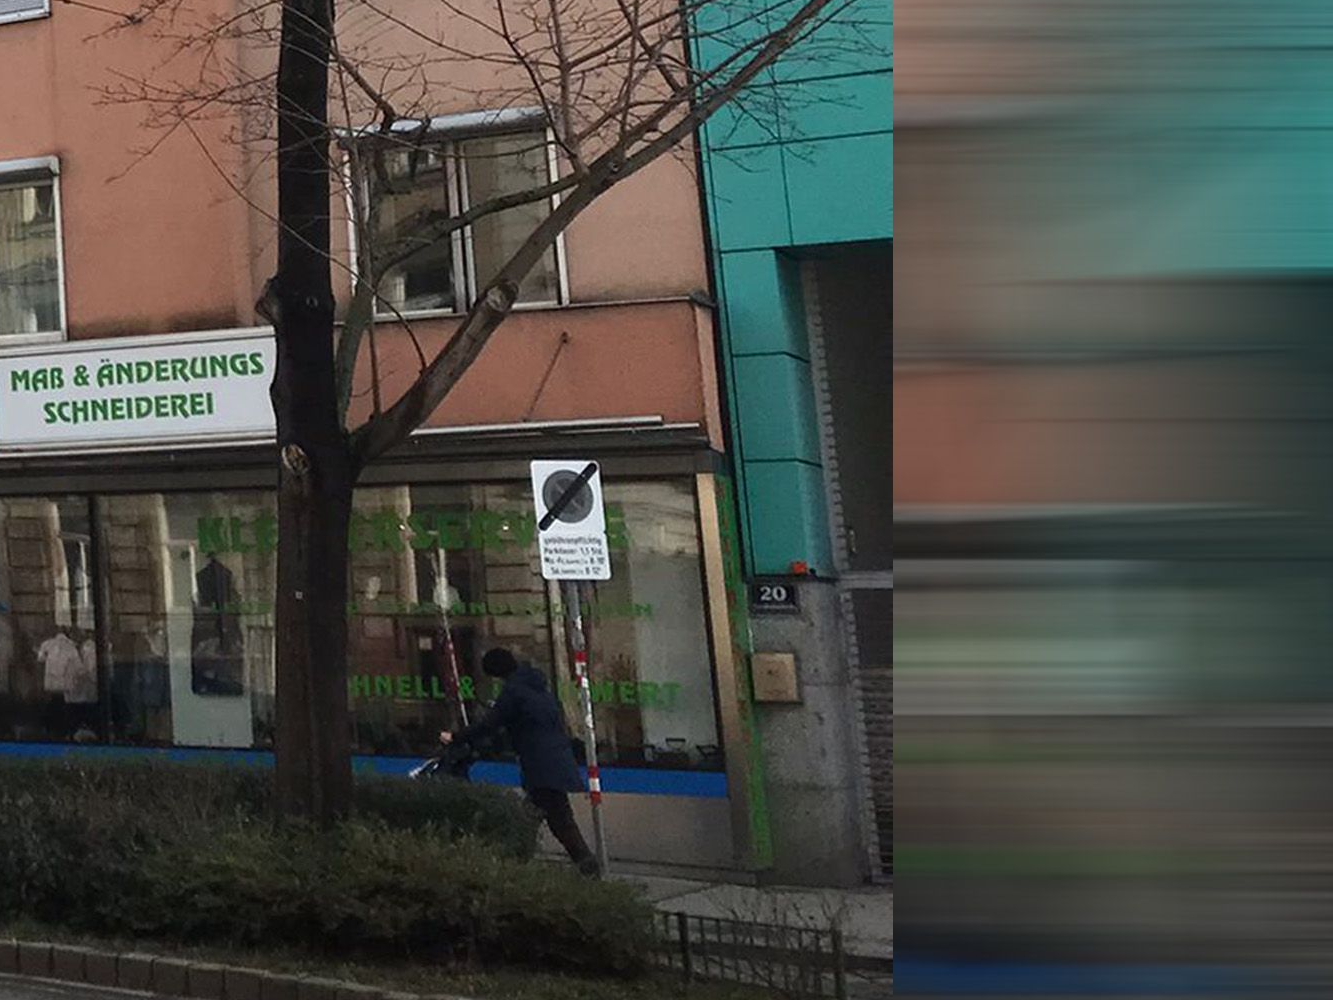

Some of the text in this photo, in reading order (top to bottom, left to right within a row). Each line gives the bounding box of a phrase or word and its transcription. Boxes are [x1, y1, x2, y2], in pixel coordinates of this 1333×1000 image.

[73, 364, 90, 387] &
[97, 352, 265, 388] ÄNDERUNGS
[43, 392, 214, 424] SCHNEIDEREI
[760, 586, 787, 601] 20
[348, 674, 446, 700] HNELL
[458, 675, 476, 700] &
